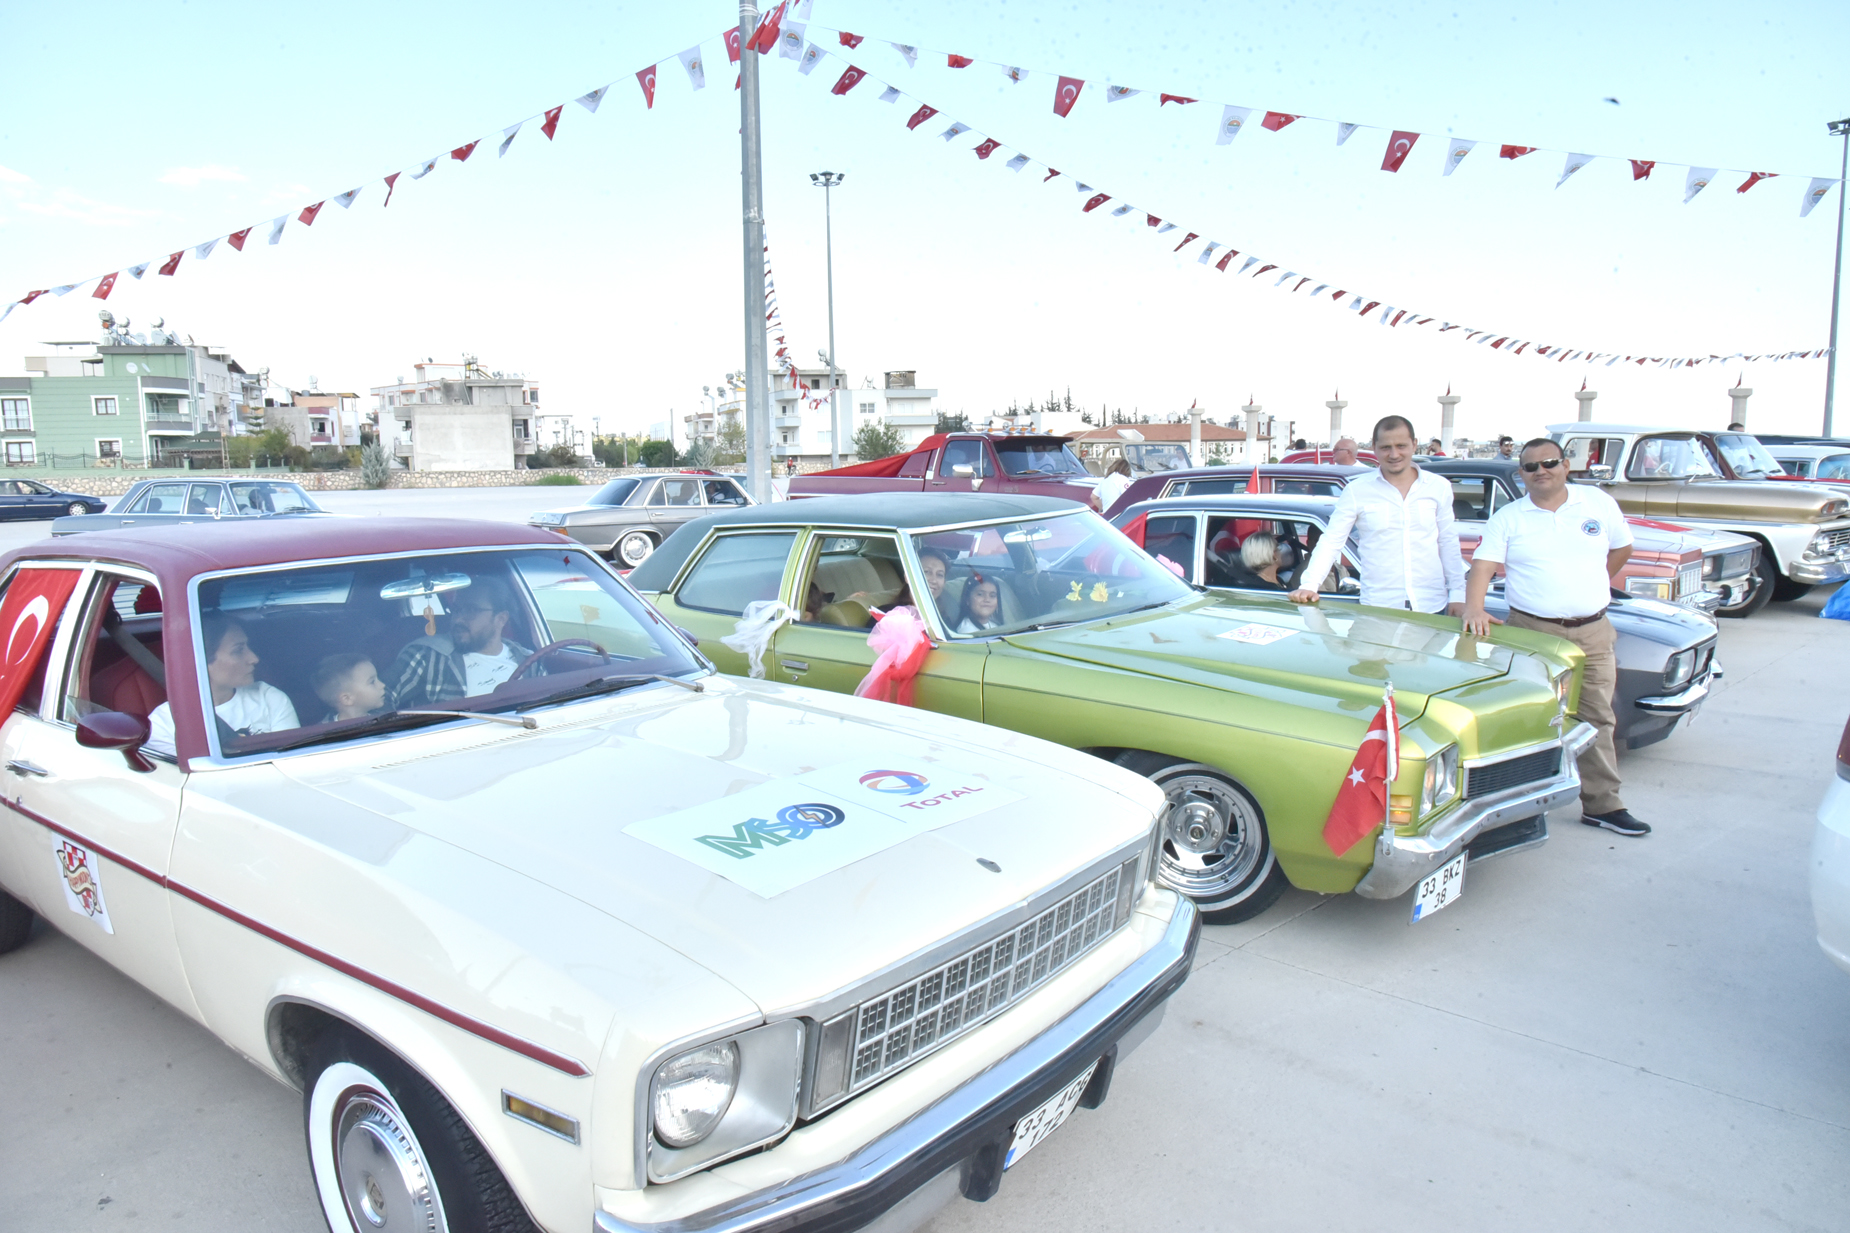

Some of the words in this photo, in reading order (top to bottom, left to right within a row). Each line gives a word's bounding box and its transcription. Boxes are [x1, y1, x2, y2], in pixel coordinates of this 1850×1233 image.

[899, 786, 984, 810] TOTAL
[1422, 877, 1436, 898] 33
[1442, 860, 1461, 886] BKZ
[1434, 887, 1447, 908] 38
[1018, 1108, 1047, 1140] 33
[1029, 1109, 1064, 1148] 172
